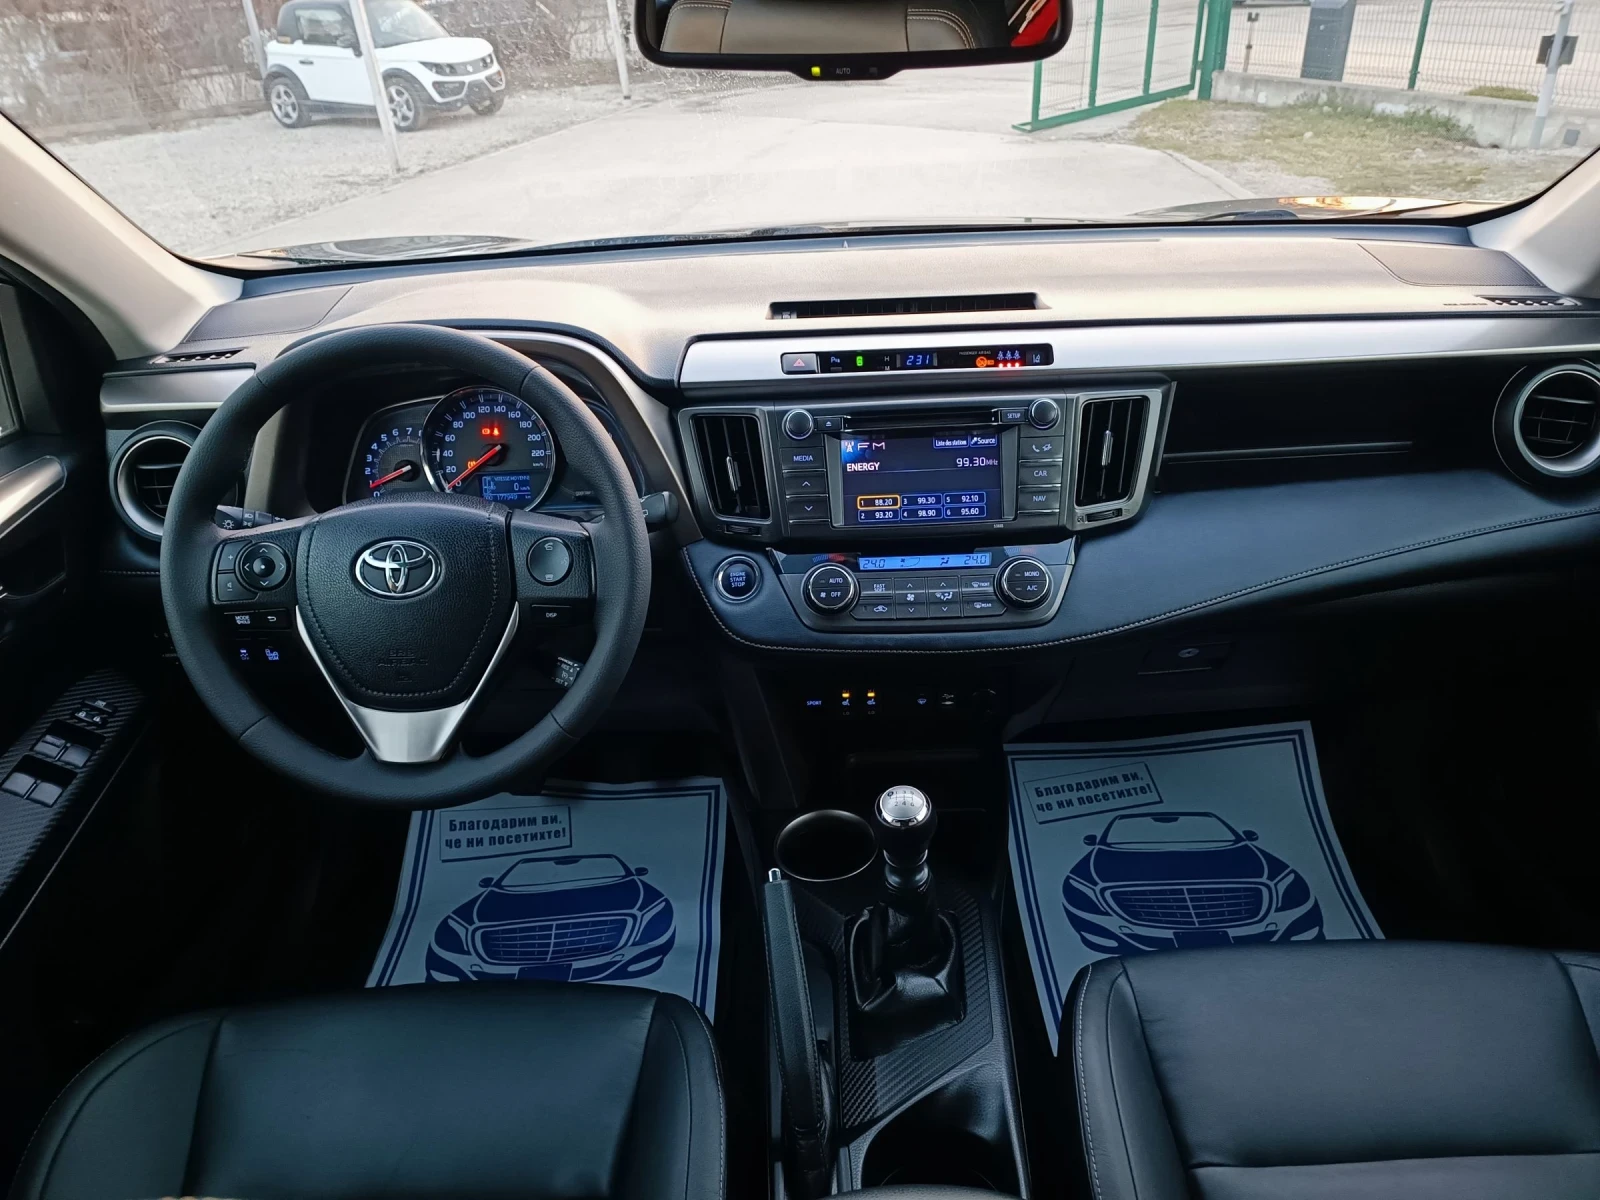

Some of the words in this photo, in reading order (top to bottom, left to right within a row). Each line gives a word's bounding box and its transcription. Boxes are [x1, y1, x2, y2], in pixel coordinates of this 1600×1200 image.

[478, 405, 490, 413] 120
[493, 405, 506, 413] 140
[406, 427, 413, 435] 7
[445, 434, 456, 442] 60
[371, 442, 378, 450] 4
[857, 442, 885, 450] FM
[366, 454, 373, 462] 3
[956, 457, 986, 467] 99.30
[365, 467, 371, 475] 2
[846, 462, 880, 472] ENERGY
[513, 482, 519, 491] 0
[875, 511, 894, 519] 93.20
[917, 509, 936, 517] 98.90
[862, 559, 886, 569] 24.0
[964, 555, 987, 565] 24.0
[1034, 774, 1120, 798] Благодарим
[1036, 801, 1053, 812] че
[1057, 798, 1075, 809] ни
[1077, 783, 1153, 806] посетихте!
[449, 815, 537, 832] Благодарим
[445, 838, 462, 849] че
[466, 837, 484, 848] ни
[488, 827, 567, 846] посетихте!
